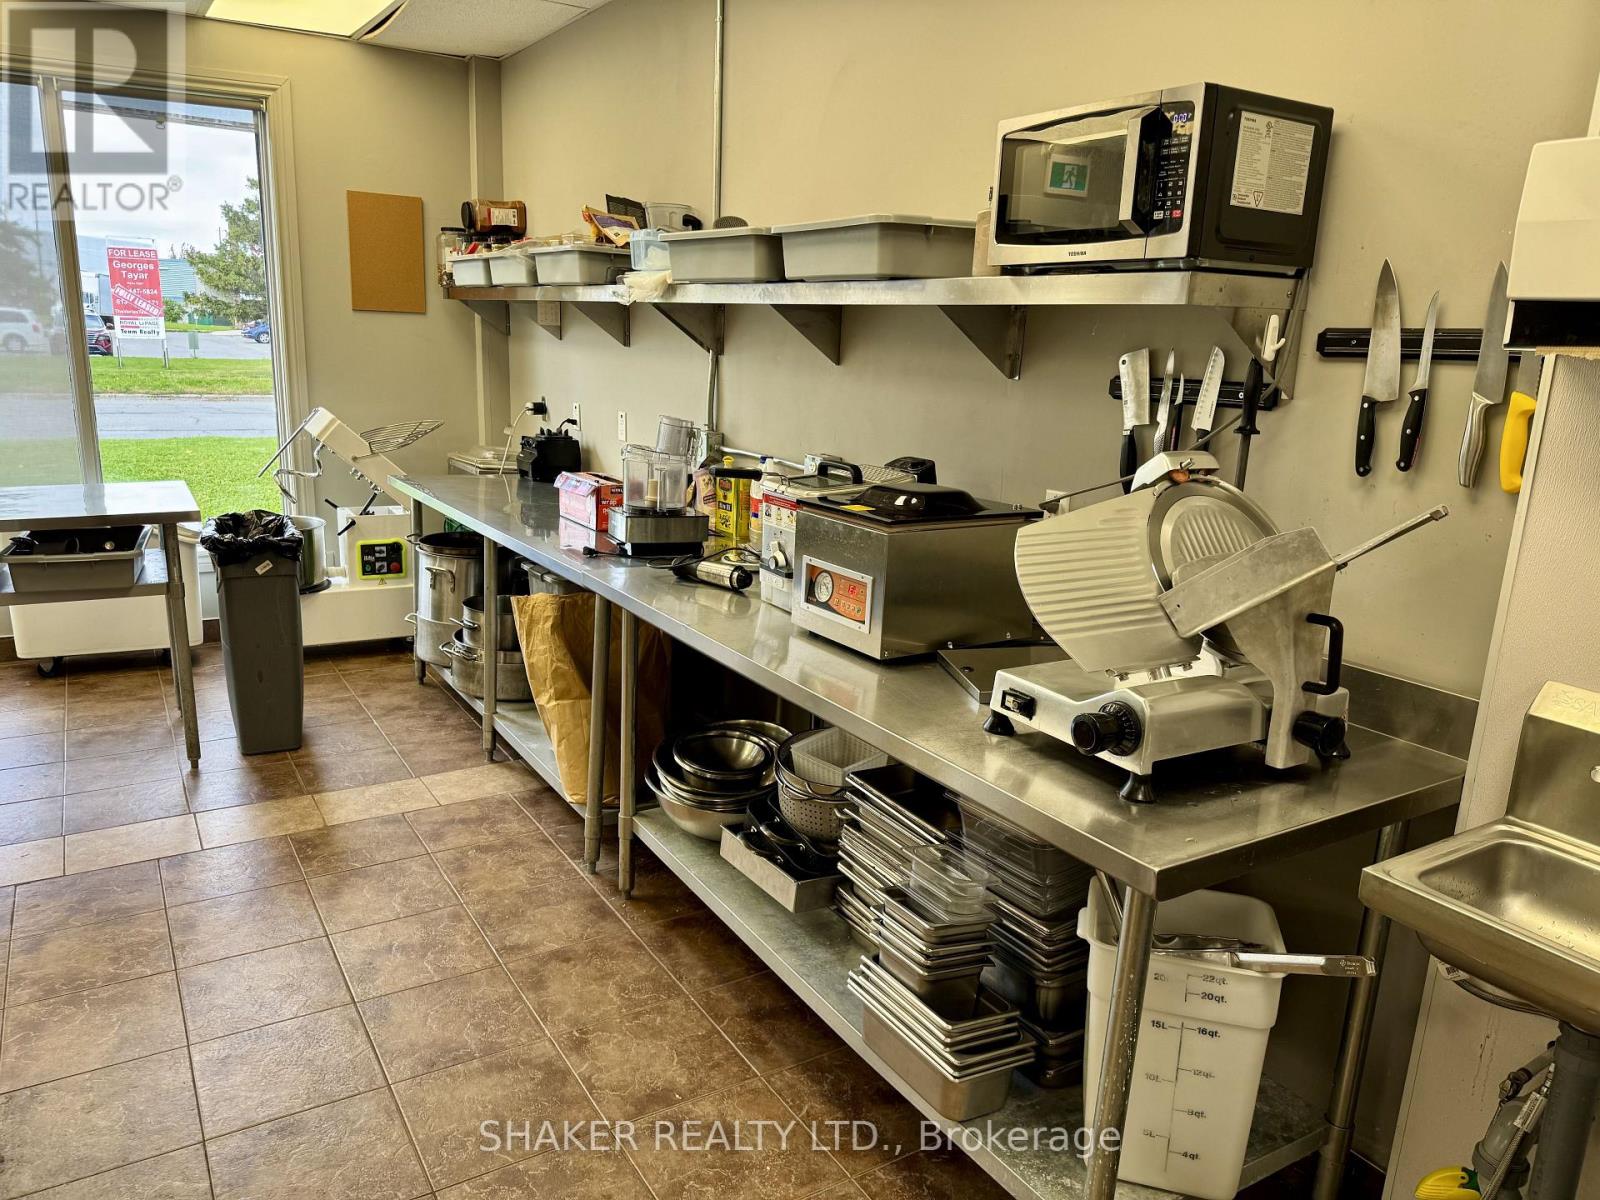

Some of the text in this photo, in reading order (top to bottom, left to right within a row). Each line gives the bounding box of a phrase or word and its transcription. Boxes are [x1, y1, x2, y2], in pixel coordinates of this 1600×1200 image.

[108, 249, 156, 258] FOR LEASE
[112, 260, 154, 271] Georges
[121, 271, 149, 280] Tayar
[114, 285, 136, 303] FULLY
[134, 297, 160, 317] LEASED
[1201, 974, 1229, 986] 22qt.
[1200, 991, 1228, 1004] 20qt.
[1150, 1020, 1221, 1039] 15L 16qt.
